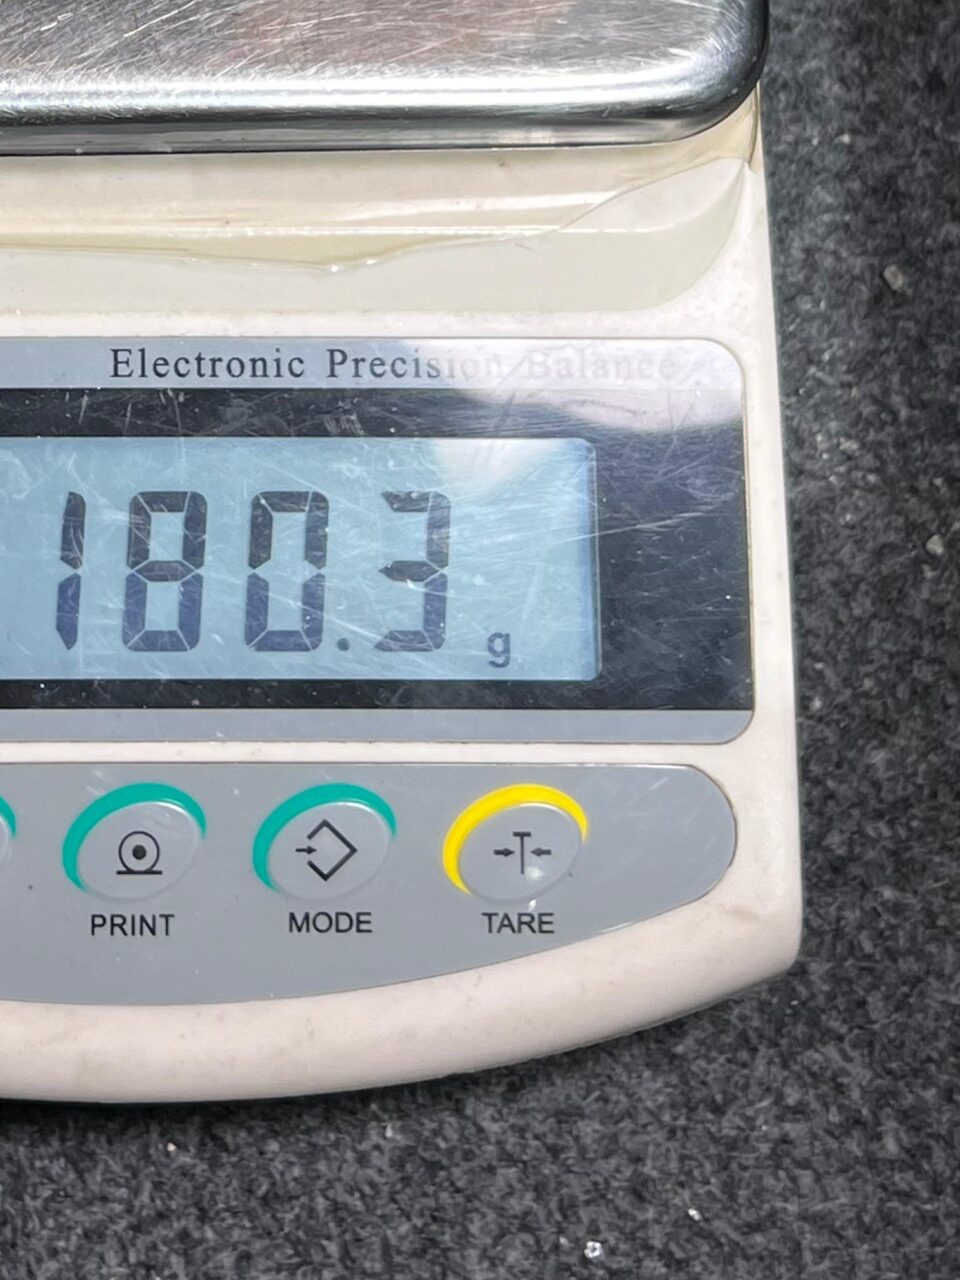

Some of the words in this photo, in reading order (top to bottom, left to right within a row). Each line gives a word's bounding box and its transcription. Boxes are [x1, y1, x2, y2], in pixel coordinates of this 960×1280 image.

[110, 347, 305, 380] Electronic
[327, 347, 506, 381] Precision
[529, 347, 676, 381] Balance
[487, 627, 512, 668] g
[90, 914, 176, 937] PRINT
[288, 911, 373, 934] MODE
[482, 912, 556, 935] TARE
